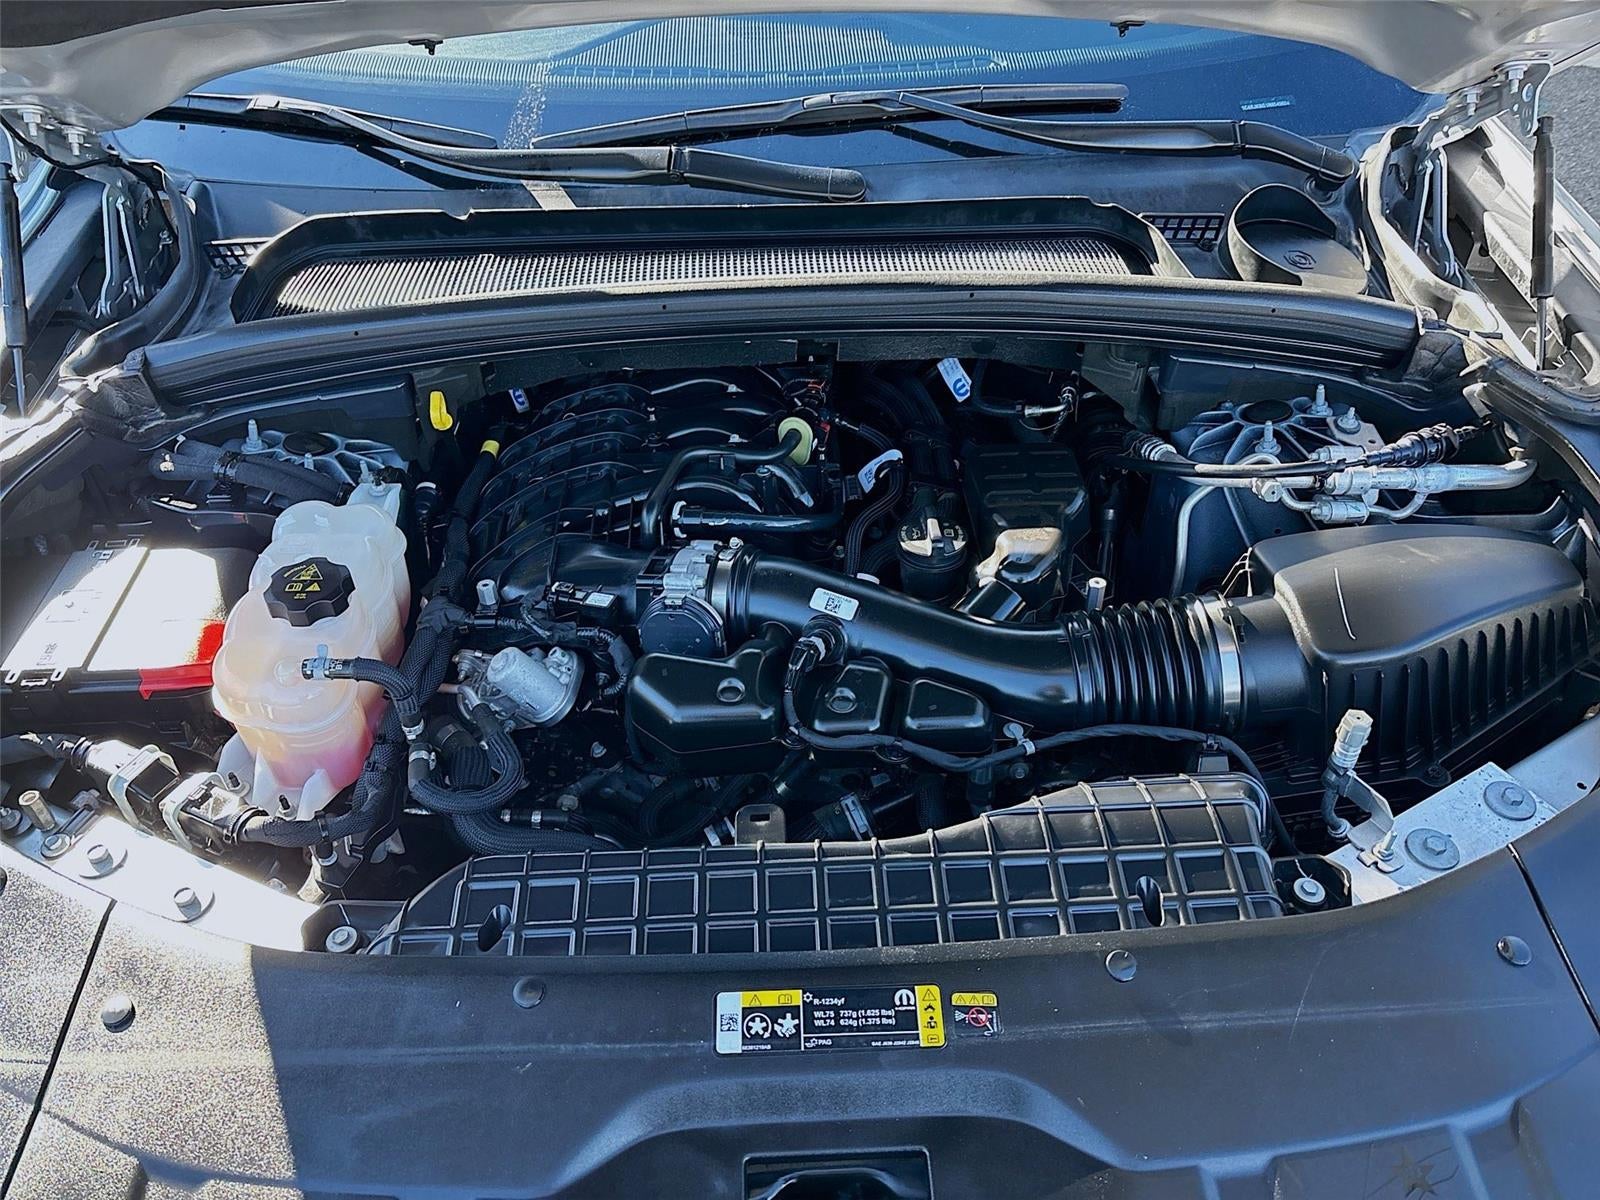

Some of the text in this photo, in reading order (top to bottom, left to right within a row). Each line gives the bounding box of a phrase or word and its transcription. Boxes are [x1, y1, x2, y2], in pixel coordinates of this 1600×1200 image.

[813, 998, 845, 1006] R-1234yf
[839, 1010, 857, 1018] 737g
[858, 1009, 879, 1018] (1.625
[881, 1009, 895, 1017] lbs)
[814, 1017, 896, 1027] WL74 624g (1.375 lbs)
